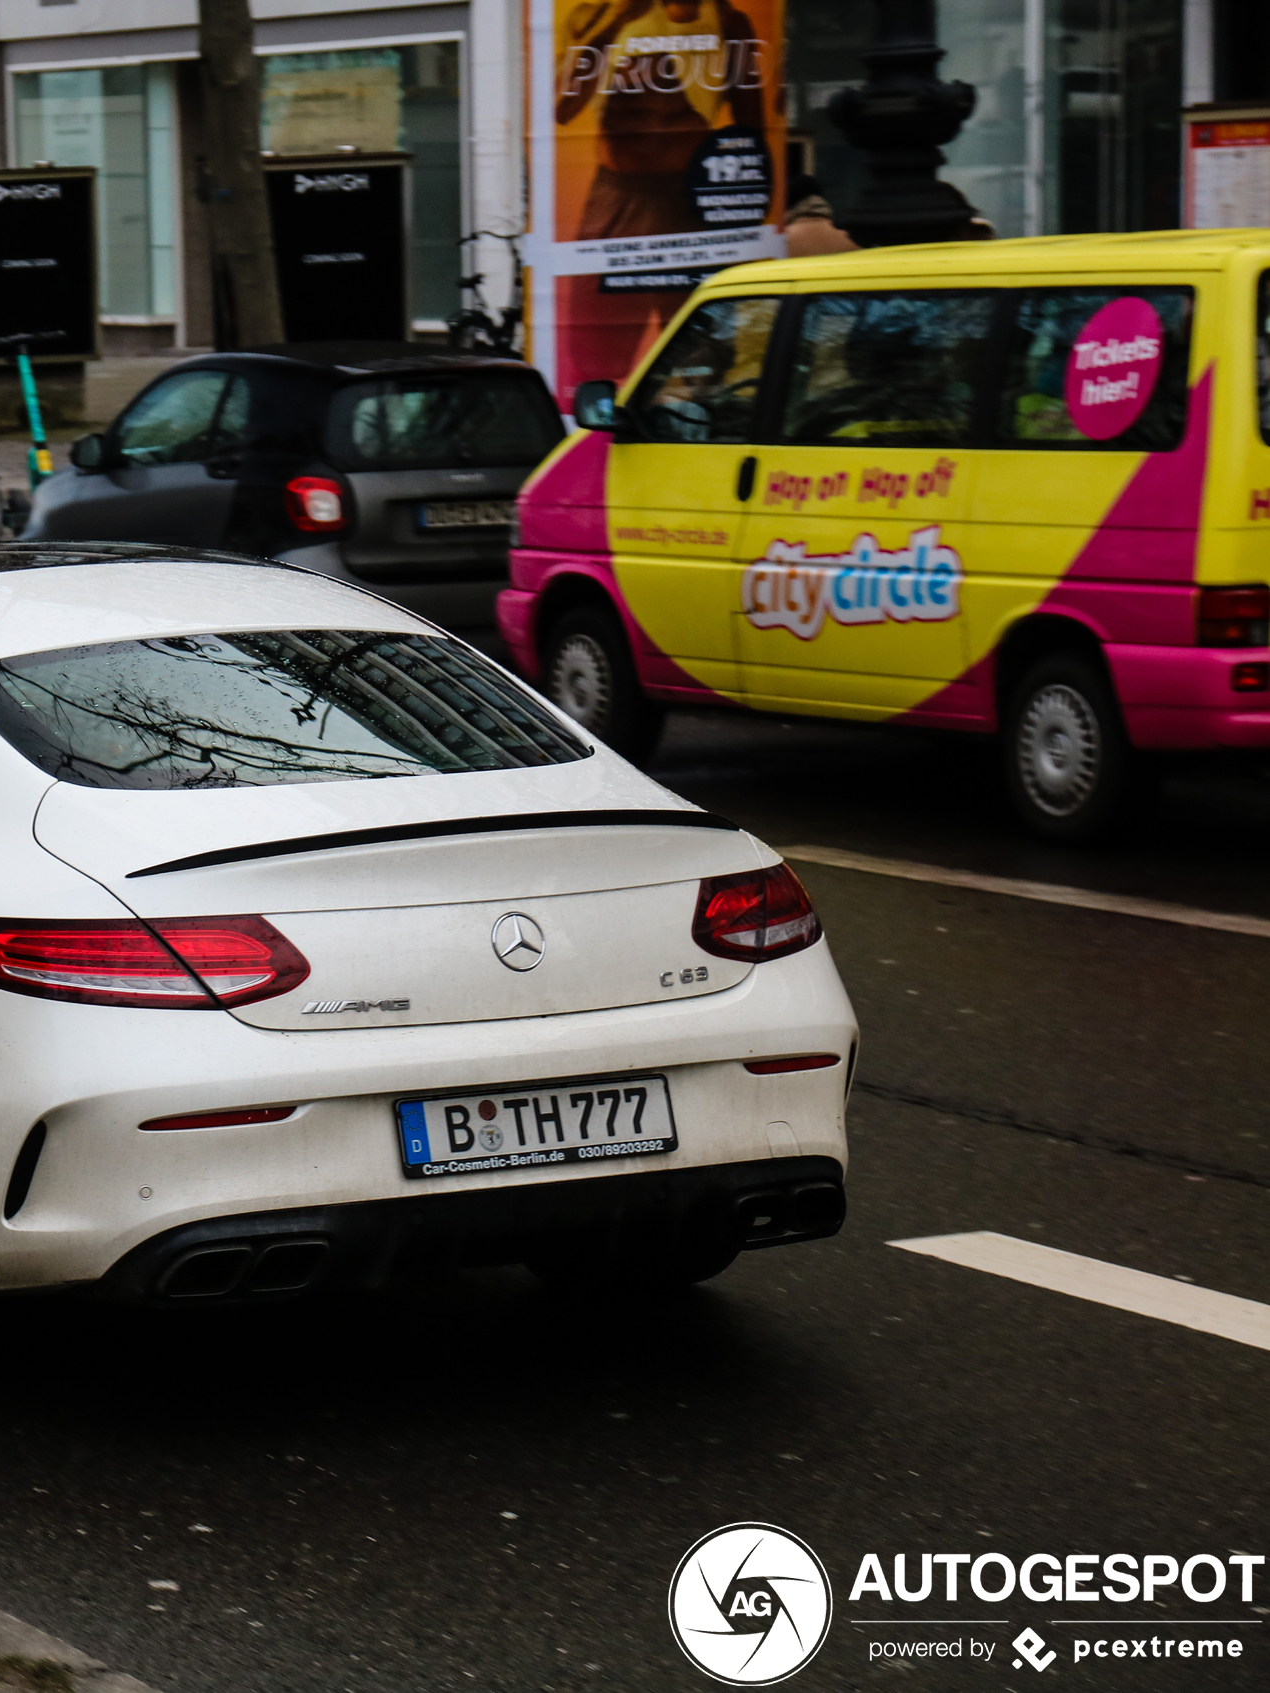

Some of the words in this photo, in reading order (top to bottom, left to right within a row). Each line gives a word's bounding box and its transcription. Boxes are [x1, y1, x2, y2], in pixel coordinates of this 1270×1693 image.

[626, 35, 720, 53] FOREVER
[560, 39, 770, 95] PROUD
[1074, 335, 1160, 370] Tickets
[1081, 372, 1140, 406] hier!
[764, 471, 812, 511] Hop
[817, 471, 850, 500] on
[857, 467, 910, 508] Hop
[915, 457, 957, 498] off
[659, 971, 674, 987] C
[679, 966, 708, 985] 63
[411, 1139, 422, 1153] D
[444, 1104, 475, 1153] B
[422, 1150, 565, 1175] Car-Cosmetic-Berlin.de
[578, 1139, 665, 1159] 030/89203292
